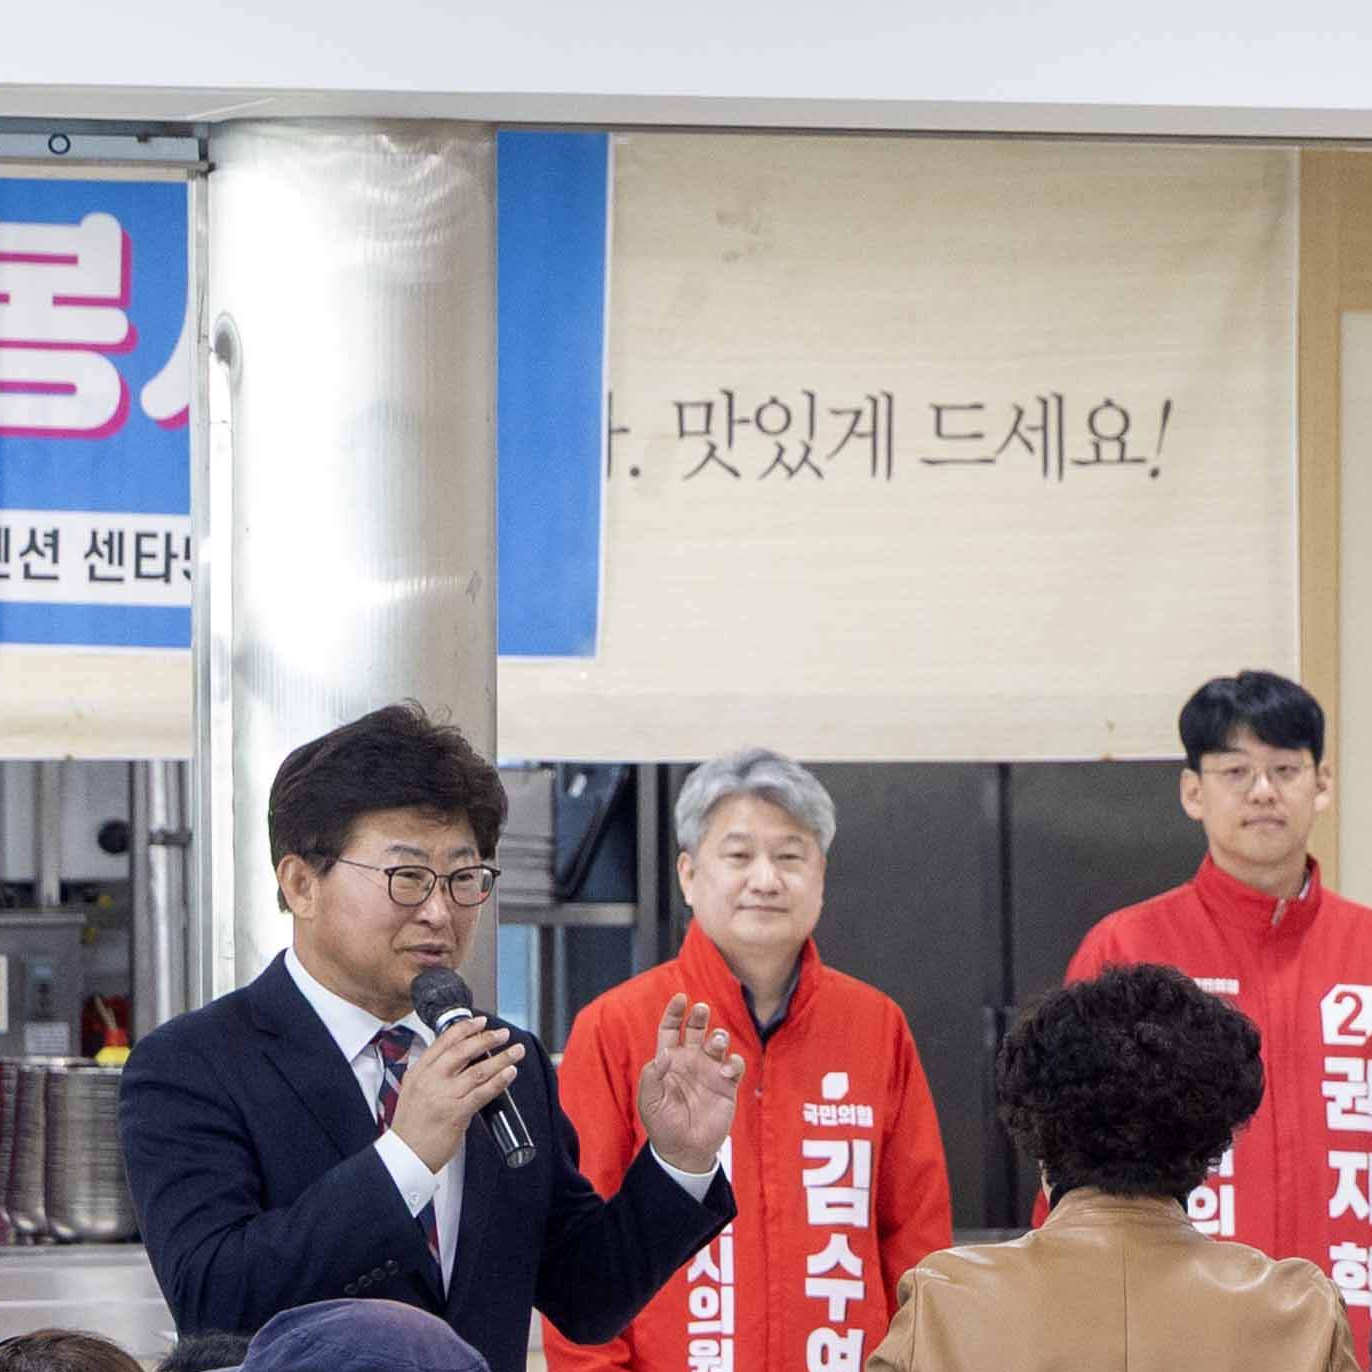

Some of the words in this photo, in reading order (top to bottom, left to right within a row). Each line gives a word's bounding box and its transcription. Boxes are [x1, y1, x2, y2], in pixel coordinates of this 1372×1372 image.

[673, 389, 894, 482] 맛있게
[920, 391, 1174, 482] 드세요!
[84, 528, 190, 584] 센타
